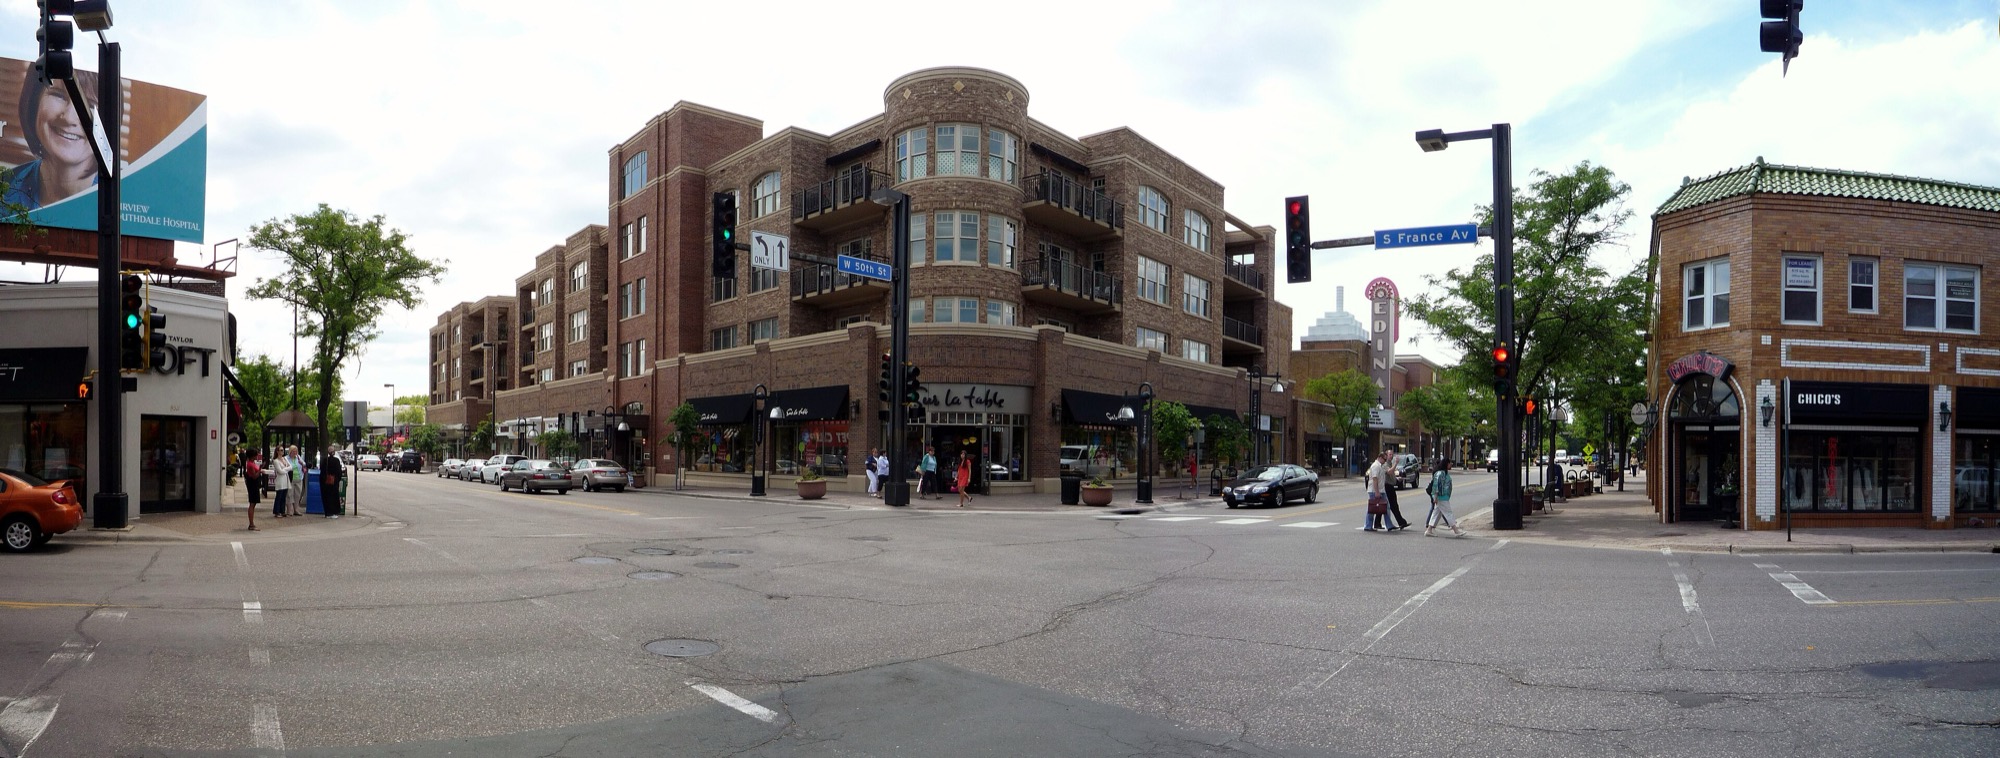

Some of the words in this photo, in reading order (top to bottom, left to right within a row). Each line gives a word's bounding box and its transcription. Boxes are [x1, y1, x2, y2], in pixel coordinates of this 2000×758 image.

[120, 203, 150, 213] IRVIEW
[121, 214, 162, 226] UTHDALE
[163, 217, 201, 231] HOSPITAL
[1383, 234, 1391, 244] S
[1398, 232, 1443, 244] France
[1451, 229, 1469, 240] Av
[754, 256, 770, 266] ONLY
[843, 260, 851, 269] W
[855, 263, 874, 274] 50th
[878, 267, 887, 277] St
[169, 335, 194, 344] TAYLOR
[1374, 301, 1387, 389] EDINA
[155, 344, 217, 378] OFT
[945, 388, 962, 407] la
[964, 386, 1005, 409] table
[1797, 393, 1841, 405] CHICO'S
